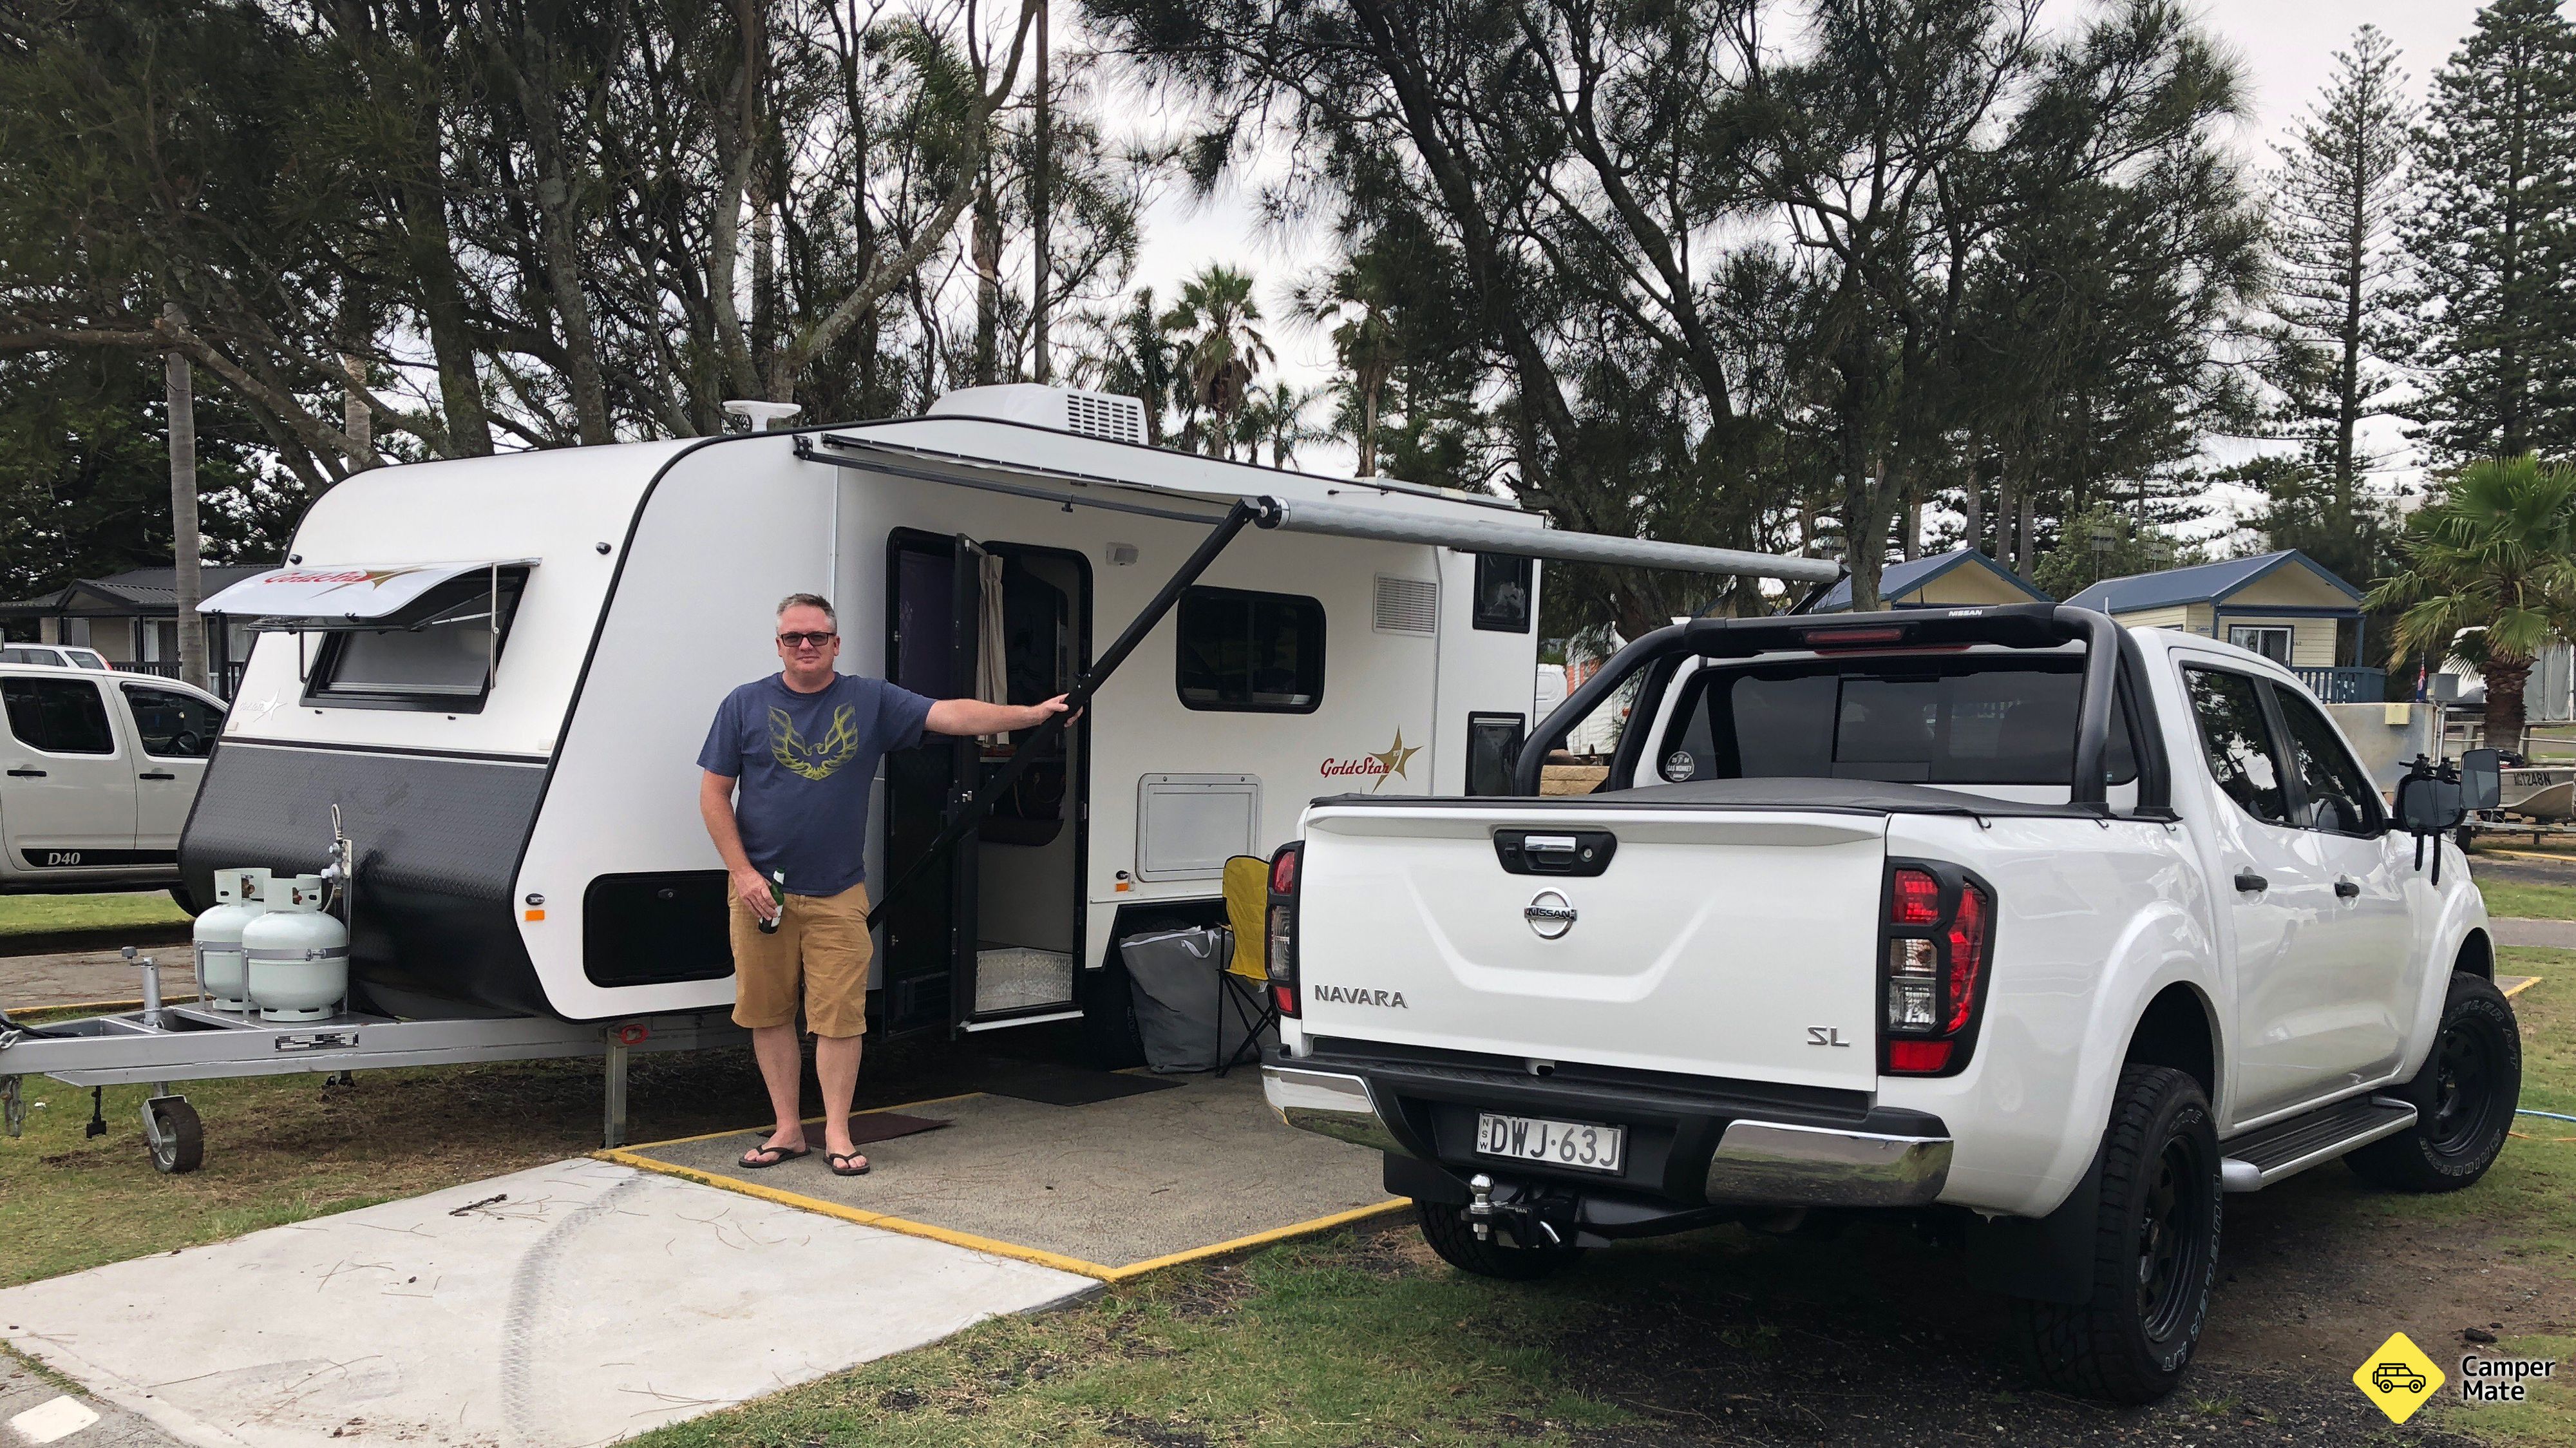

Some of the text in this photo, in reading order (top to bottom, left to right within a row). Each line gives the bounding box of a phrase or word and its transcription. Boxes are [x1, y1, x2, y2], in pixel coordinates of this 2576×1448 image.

[1948, 609, 1983, 617] NISSAN
[1320, 756, 1390, 779] GoldStar
[48, 852, 80, 865] D40
[1527, 907, 1571, 920] NISSAN
[1314, 984, 1408, 1009] NAVARA
[1807, 1025, 1850, 1047] SL
[2163, 1174, 2222, 1372] DUELER A/T
